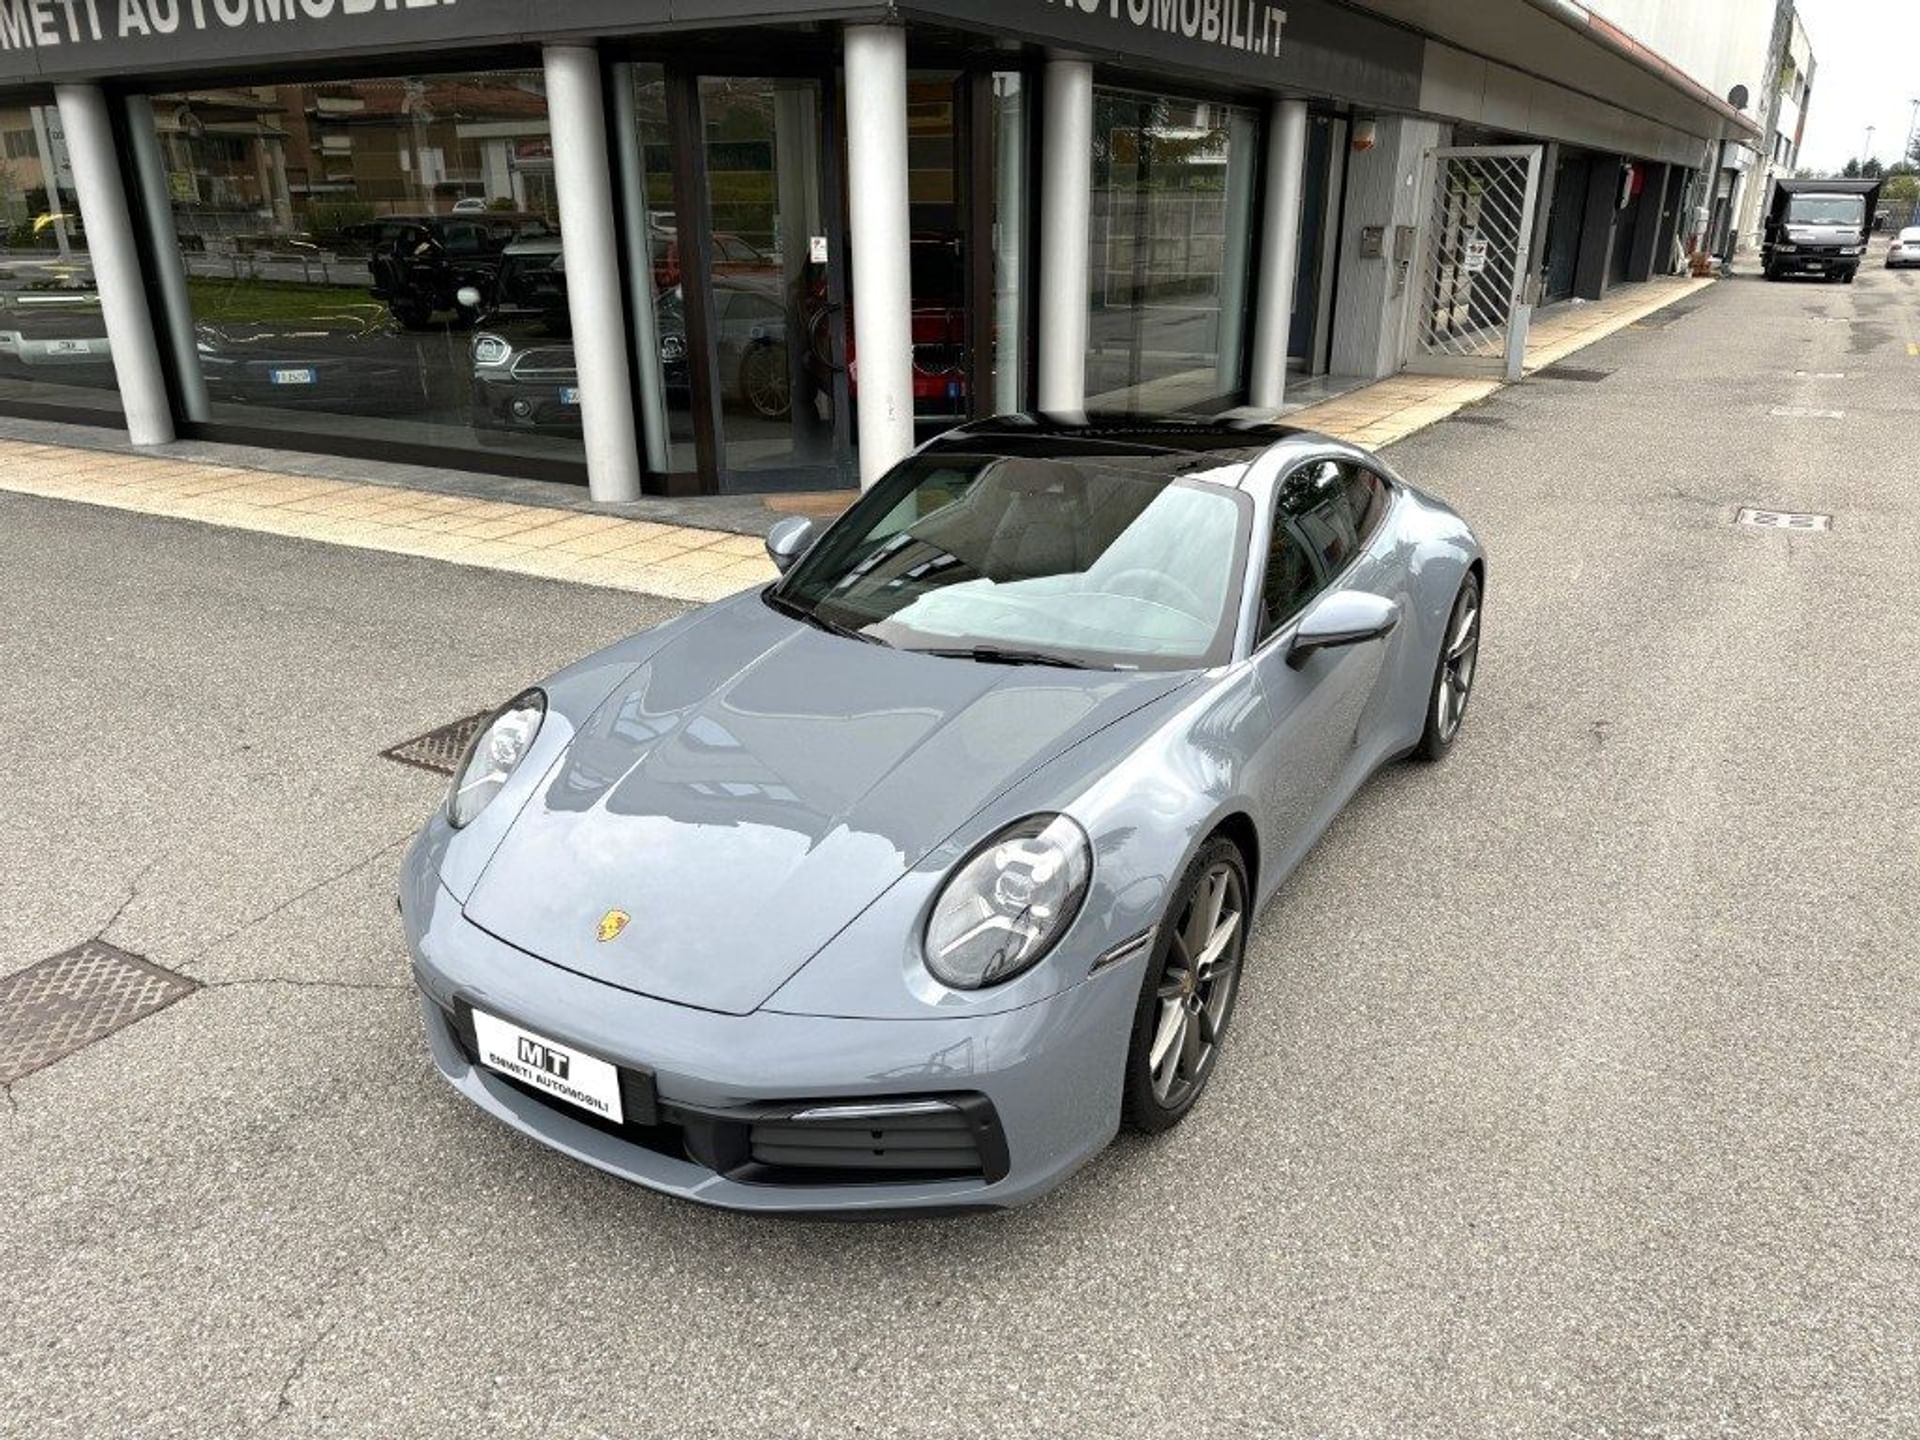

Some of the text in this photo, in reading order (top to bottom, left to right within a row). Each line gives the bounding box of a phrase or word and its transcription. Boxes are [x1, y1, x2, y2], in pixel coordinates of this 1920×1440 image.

[118, 0, 456, 37] AUTOM
[1046, 0, 1287, 57] OMOBILI.IT
[518, 1036, 569, 1080] MT
[536, 1074, 609, 1112] AUTOMOBILI
